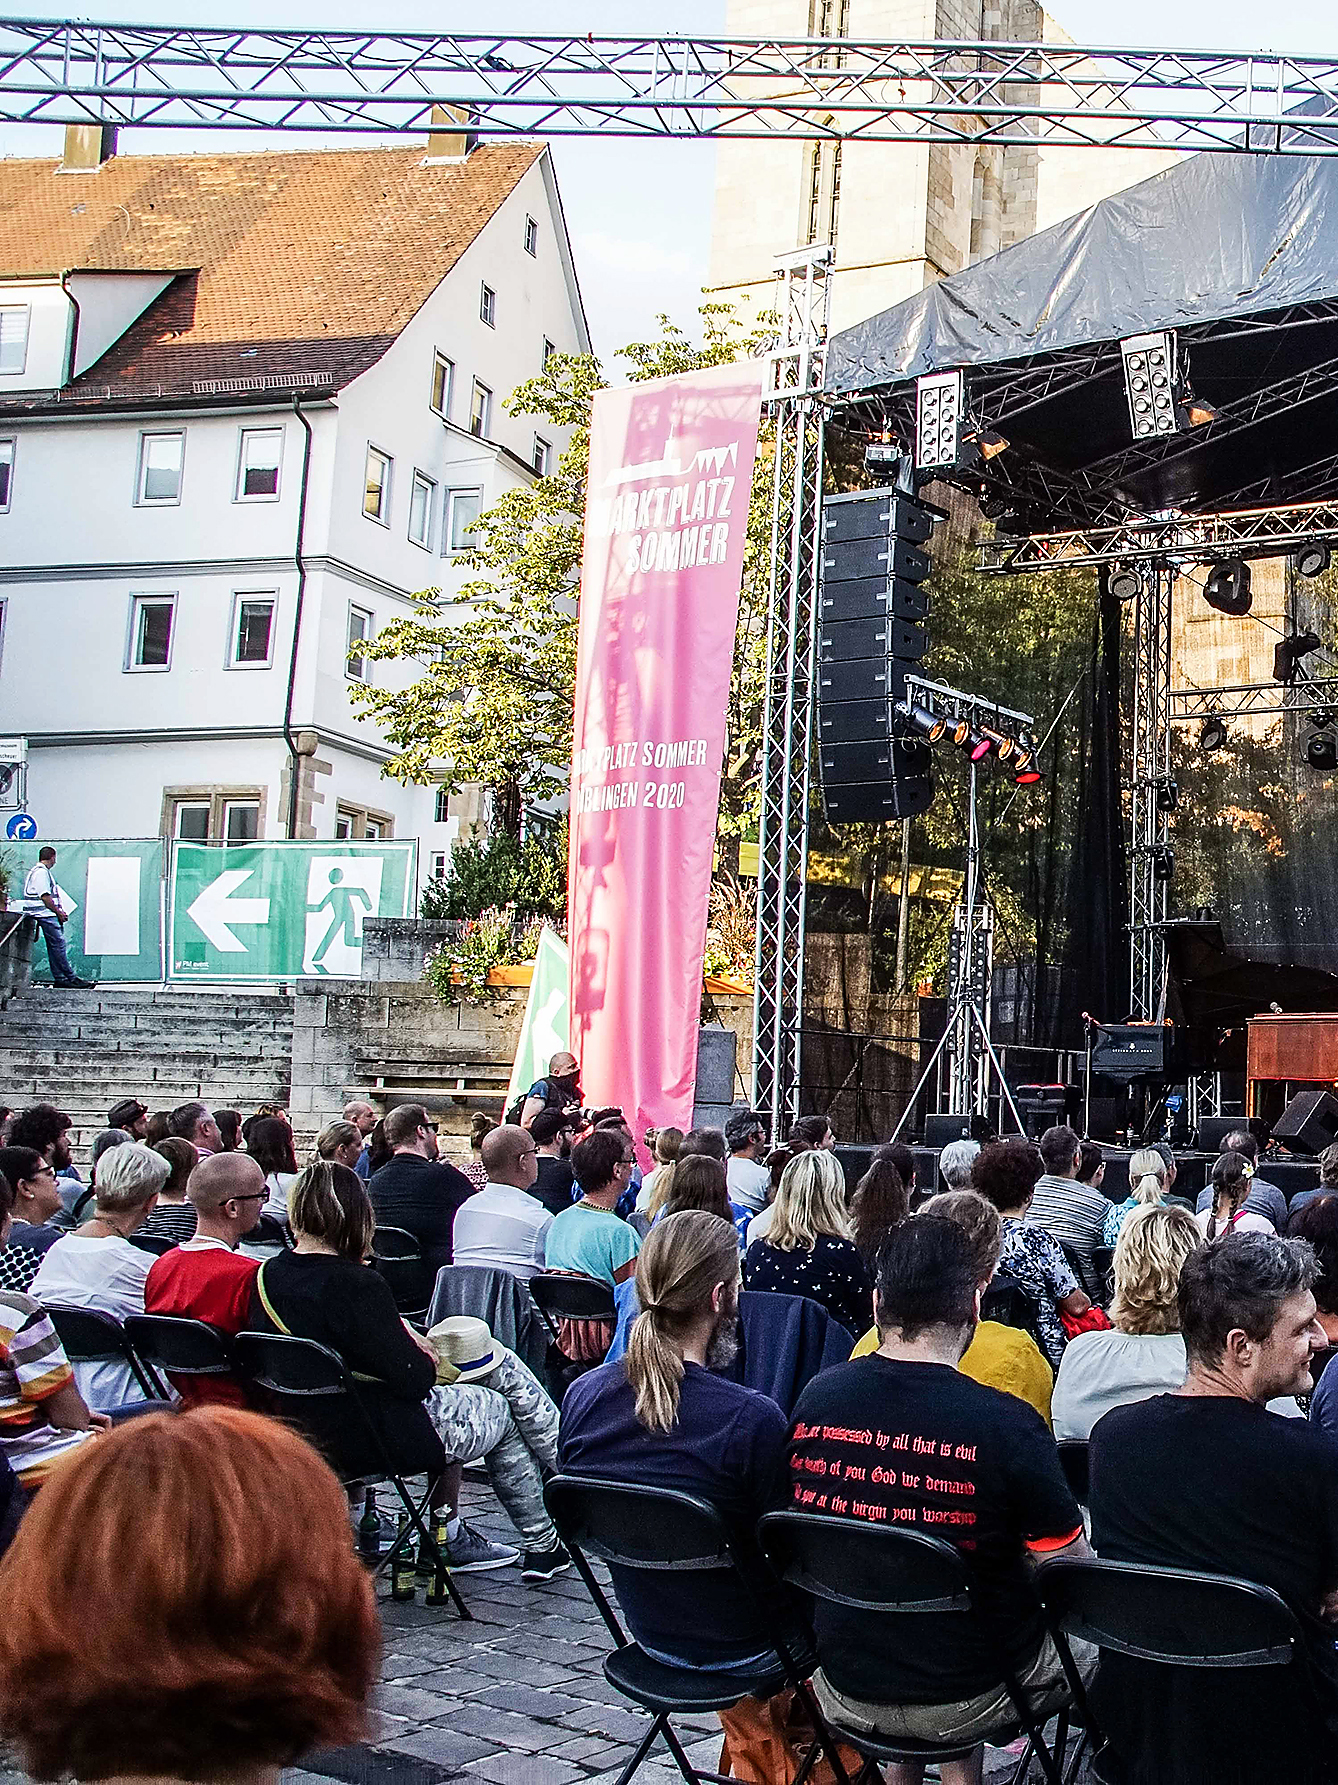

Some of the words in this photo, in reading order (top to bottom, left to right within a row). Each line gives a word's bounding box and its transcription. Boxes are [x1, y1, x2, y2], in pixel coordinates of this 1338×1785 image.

[592, 476, 735, 536] ARKTPLATZ
[625, 522, 730, 576] SOMMER
[642, 739, 707, 769] SOMMER
[643, 781, 685, 809] 2020
[875, 1430, 890, 1451] by
[892, 1433, 910, 1451] all
[912, 1436, 937, 1455] that
[940, 1440, 953, 1457] is
[954, 1446, 977, 1462] evil
[829, 1460, 841, 1475] of
[843, 1465, 866, 1481] you
[871, 1465, 896, 1485] God
[902, 1471, 920, 1488] we
[831, 1495, 848, 1514] the
[852, 1500, 887, 1521] virgin
[891, 1507, 916, 1522] you
